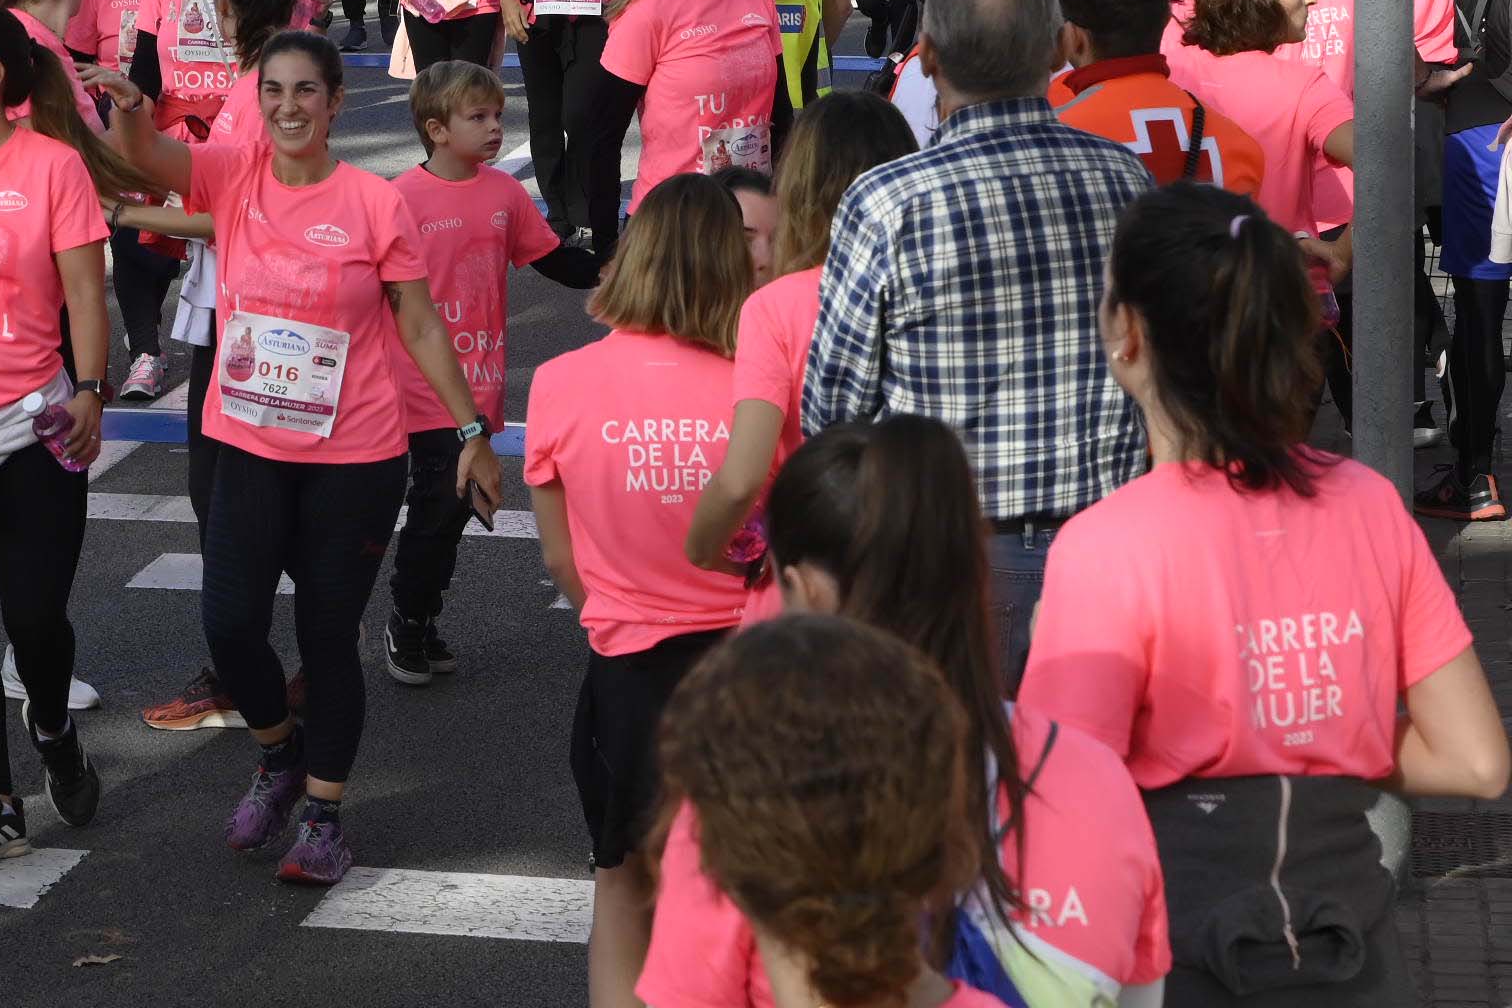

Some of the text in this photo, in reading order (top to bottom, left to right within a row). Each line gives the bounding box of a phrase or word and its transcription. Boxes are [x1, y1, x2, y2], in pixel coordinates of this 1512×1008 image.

[694, 91, 725, 116] TU
[421, 217, 463, 235] OYSHO
[259, 335, 306, 353] ASTURIANA
[258, 360, 300, 382] 016
[230, 389, 259, 402] CARRERA
[259, 396, 271, 404] DE
[270, 398, 281, 407] LA
[280, 400, 306, 410] MUJER
[262, 382, 288, 396] 7622
[286, 414, 325, 428] Santander
[601, 419, 731, 444] CARRERA
[628, 443, 708, 468] DE LA
[660, 494, 684, 504] 2023
[1300, 653, 1338, 687] LA
